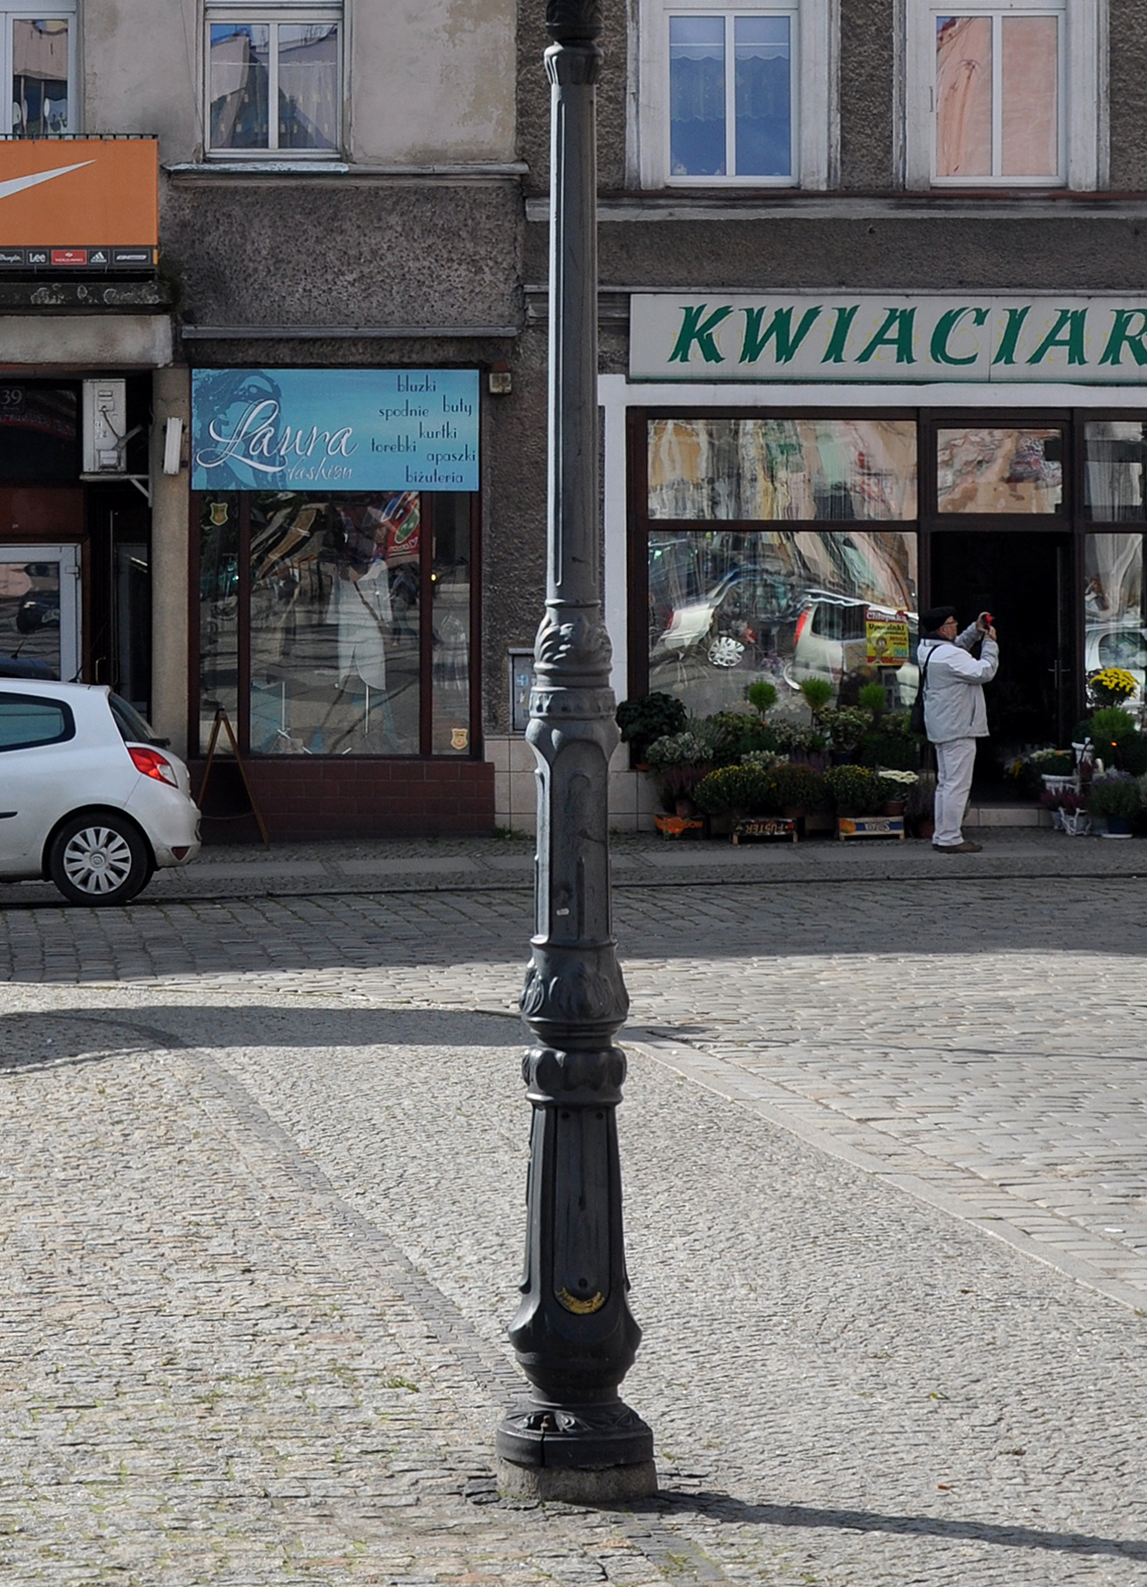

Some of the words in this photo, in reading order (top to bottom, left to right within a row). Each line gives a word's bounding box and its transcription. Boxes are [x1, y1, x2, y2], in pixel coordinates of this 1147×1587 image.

[28, 252, 46, 263] Lee
[667, 303, 1147, 366] KWIACIAR
[397, 374, 437, 393] bluzki
[0, 389, 23, 406] 39
[442, 395, 473, 417] buty
[378, 399, 430, 421] spodnie
[196, 399, 359, 473] Laura
[418, 421, 458, 440] kurtki
[371, 435, 417, 454] torebki
[426, 444, 477, 466] apaszki
[285, 457, 354, 482] fashion
[405, 466, 465, 484] biżuteria
